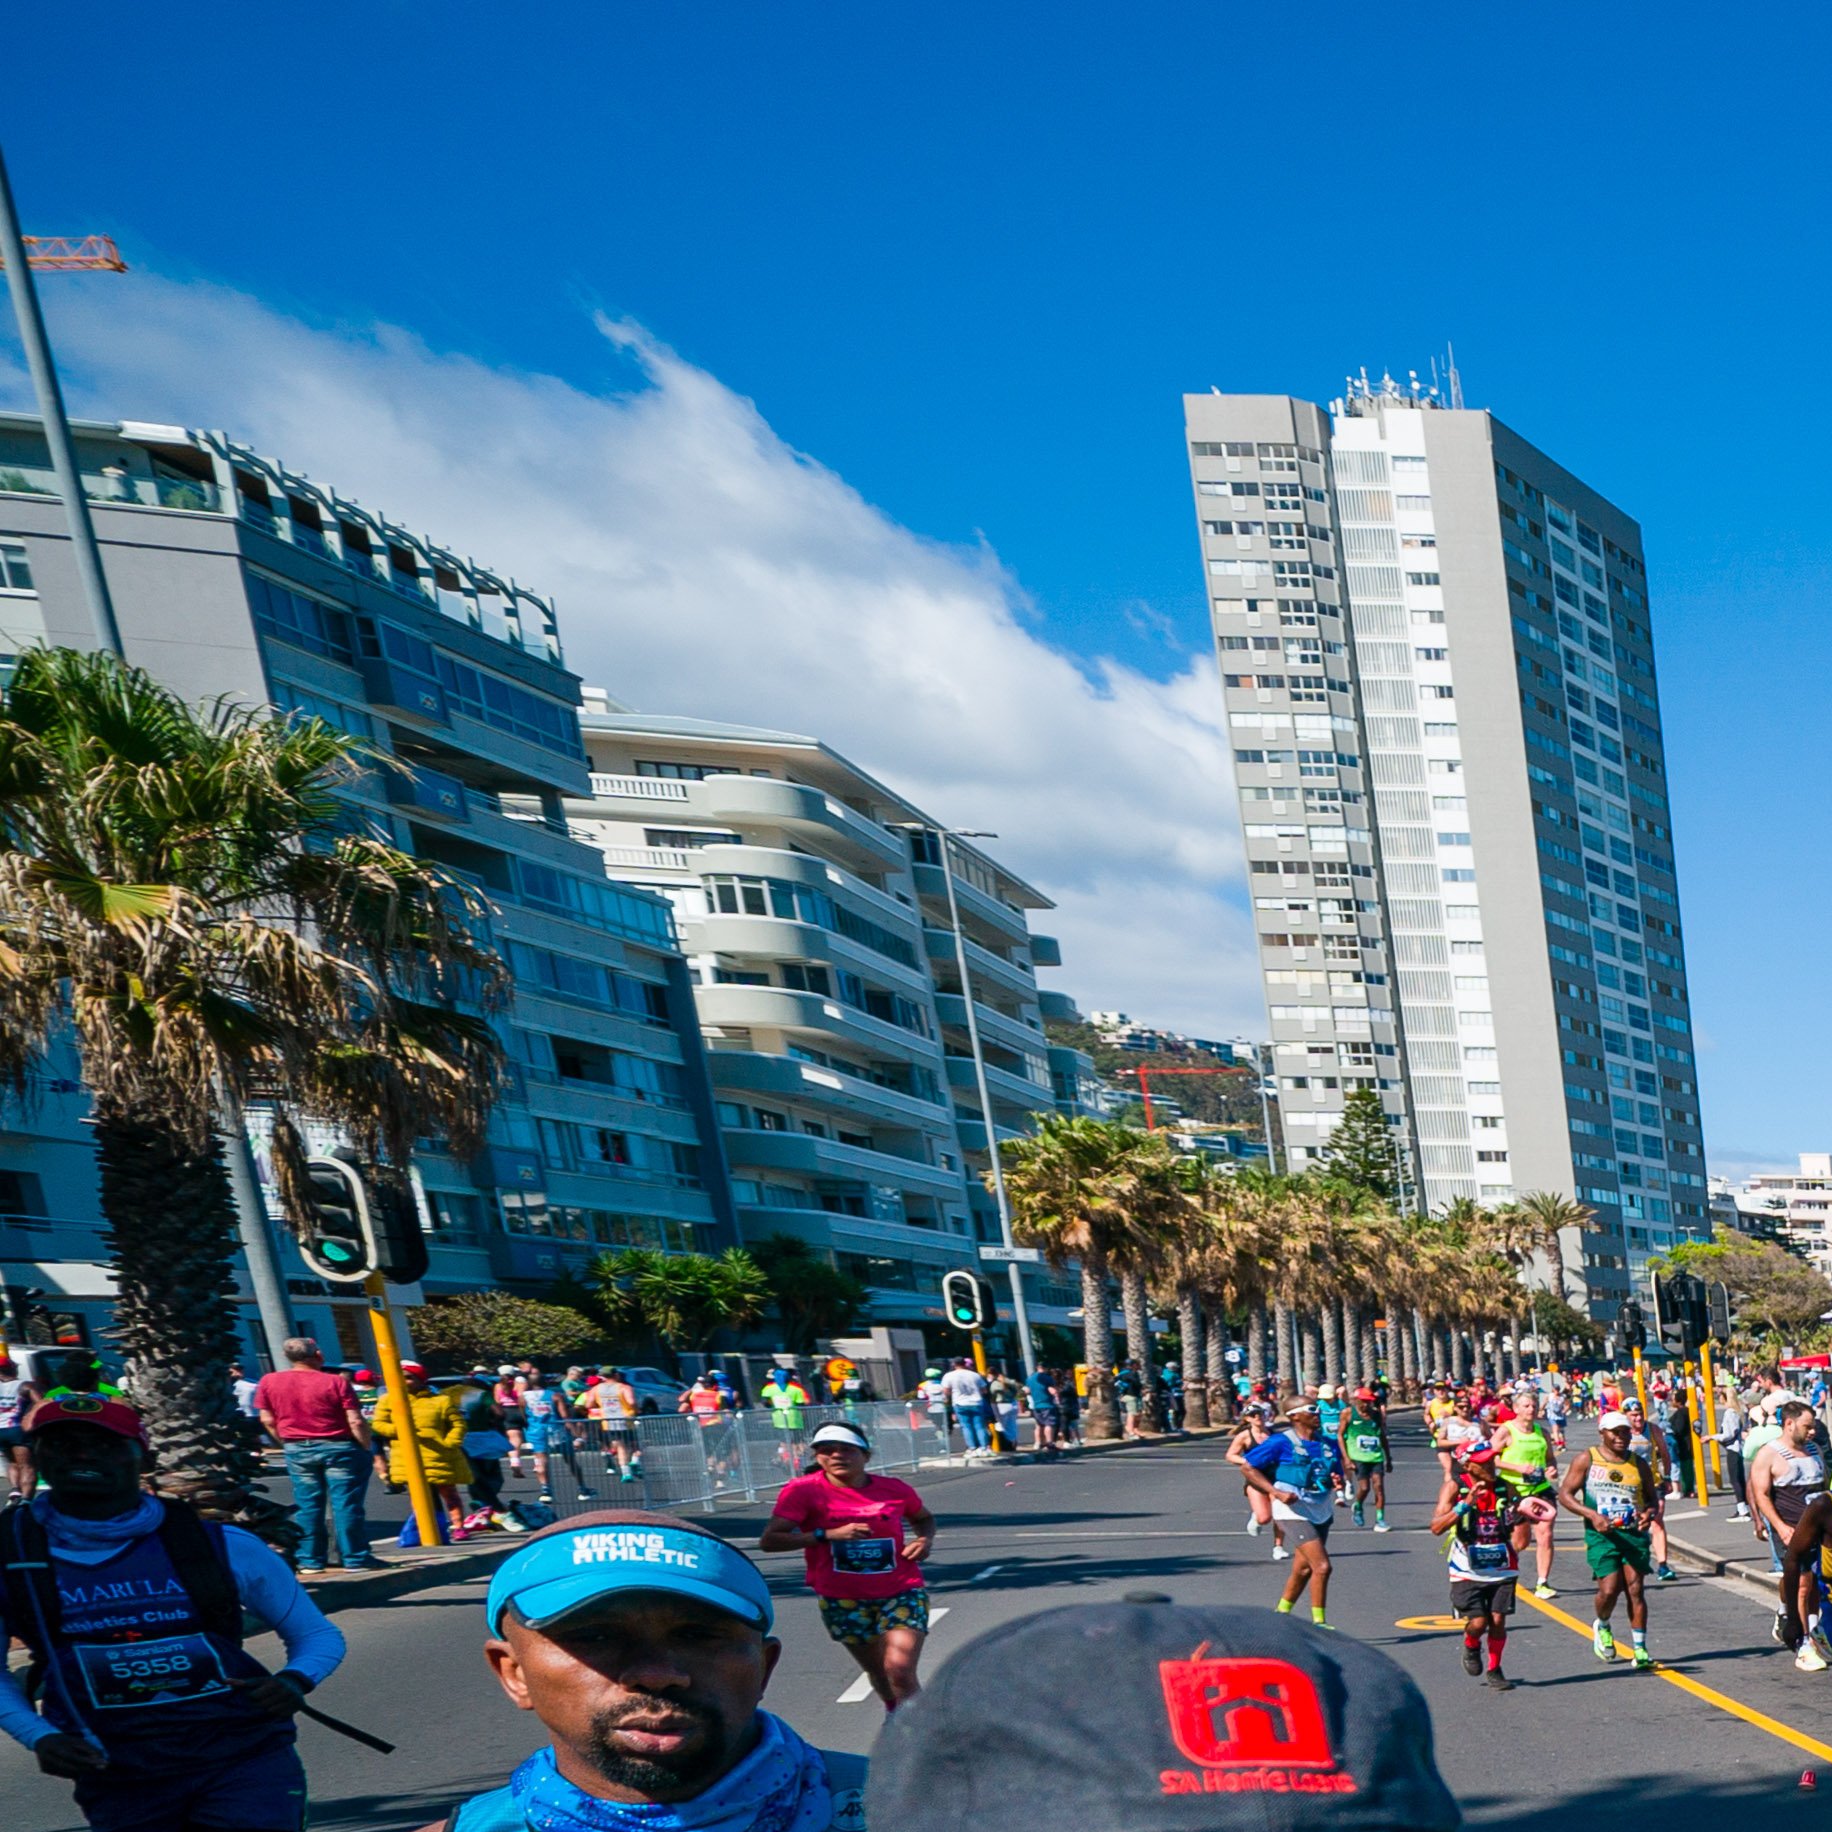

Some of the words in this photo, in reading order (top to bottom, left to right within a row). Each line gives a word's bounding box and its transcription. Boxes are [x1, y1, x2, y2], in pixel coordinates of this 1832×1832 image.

[572, 1532, 665, 1550] VIKING
[572, 1546, 700, 1569] ATHLETIC
[143, 1608, 190, 1624] Club
[109, 1654, 193, 1679] 5358
[1158, 1768, 1202, 1795] SA
[1202, 1767, 1290, 1793] Home
